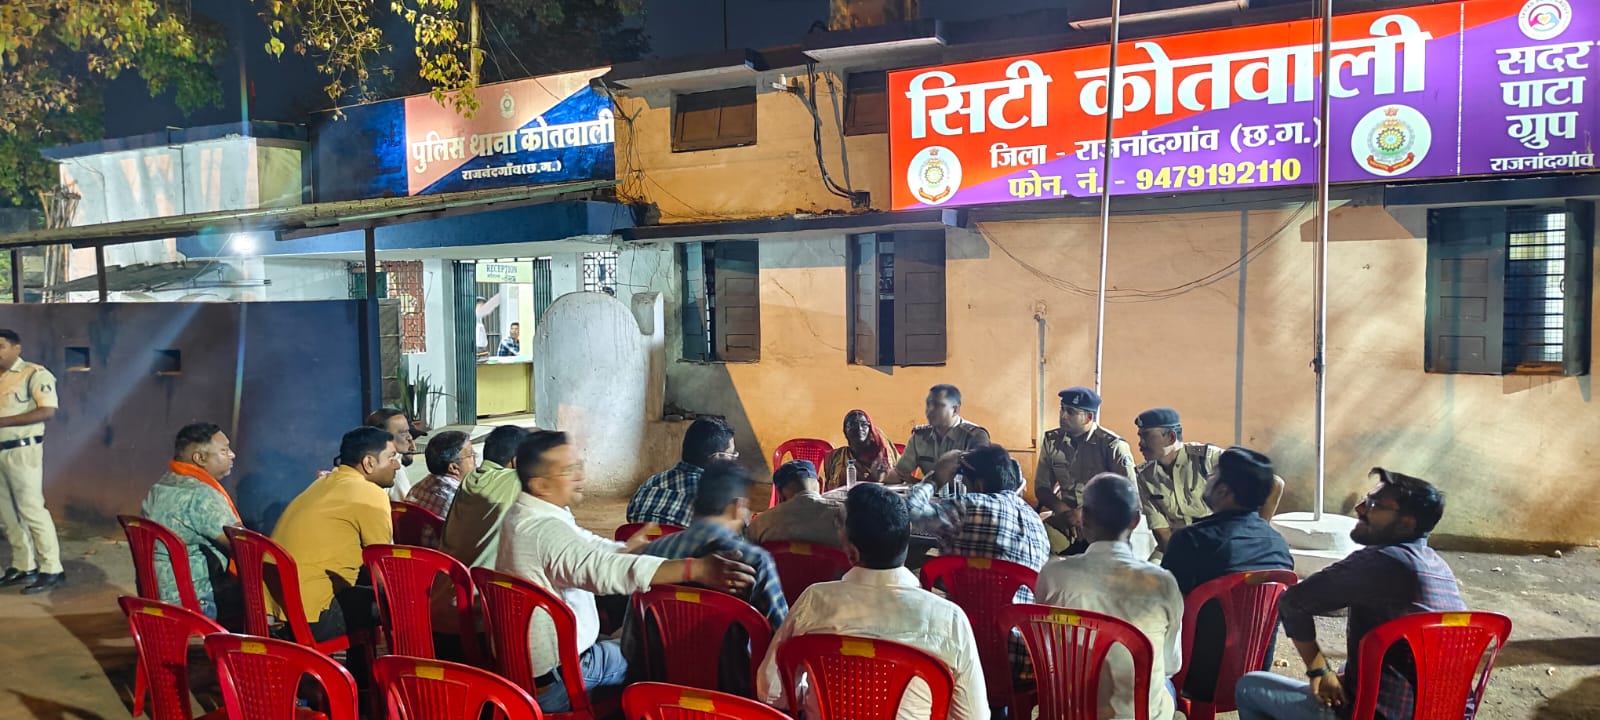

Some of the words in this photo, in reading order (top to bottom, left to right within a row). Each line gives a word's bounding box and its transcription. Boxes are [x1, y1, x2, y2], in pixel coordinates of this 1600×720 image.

[905, 60, 1052, 139] सिटी
[1074, 14, 1433, 119] कोतवाली
[1495, 40, 1594, 75] सदर
[1499, 76, 1587, 108] पाटा
[411, 130, 465, 174] पुलिस
[469, 129, 517, 157] थाना
[520, 107, 615, 151] कोतवाली
[989, 142, 1047, 168] जिला
[1075, 125, 1220, 161] राजनांदगांव
[1230, 117, 1321, 152] (छ.ग.)
[1505, 111, 1579, 149] ग्रुप
[1008, 169, 1068, 198] फोन.
[1136, 158, 1301, 190] 9479192110
[1489, 151, 1594, 171] राजनांदगांव
[486, 264, 518, 273] RECEPTION
